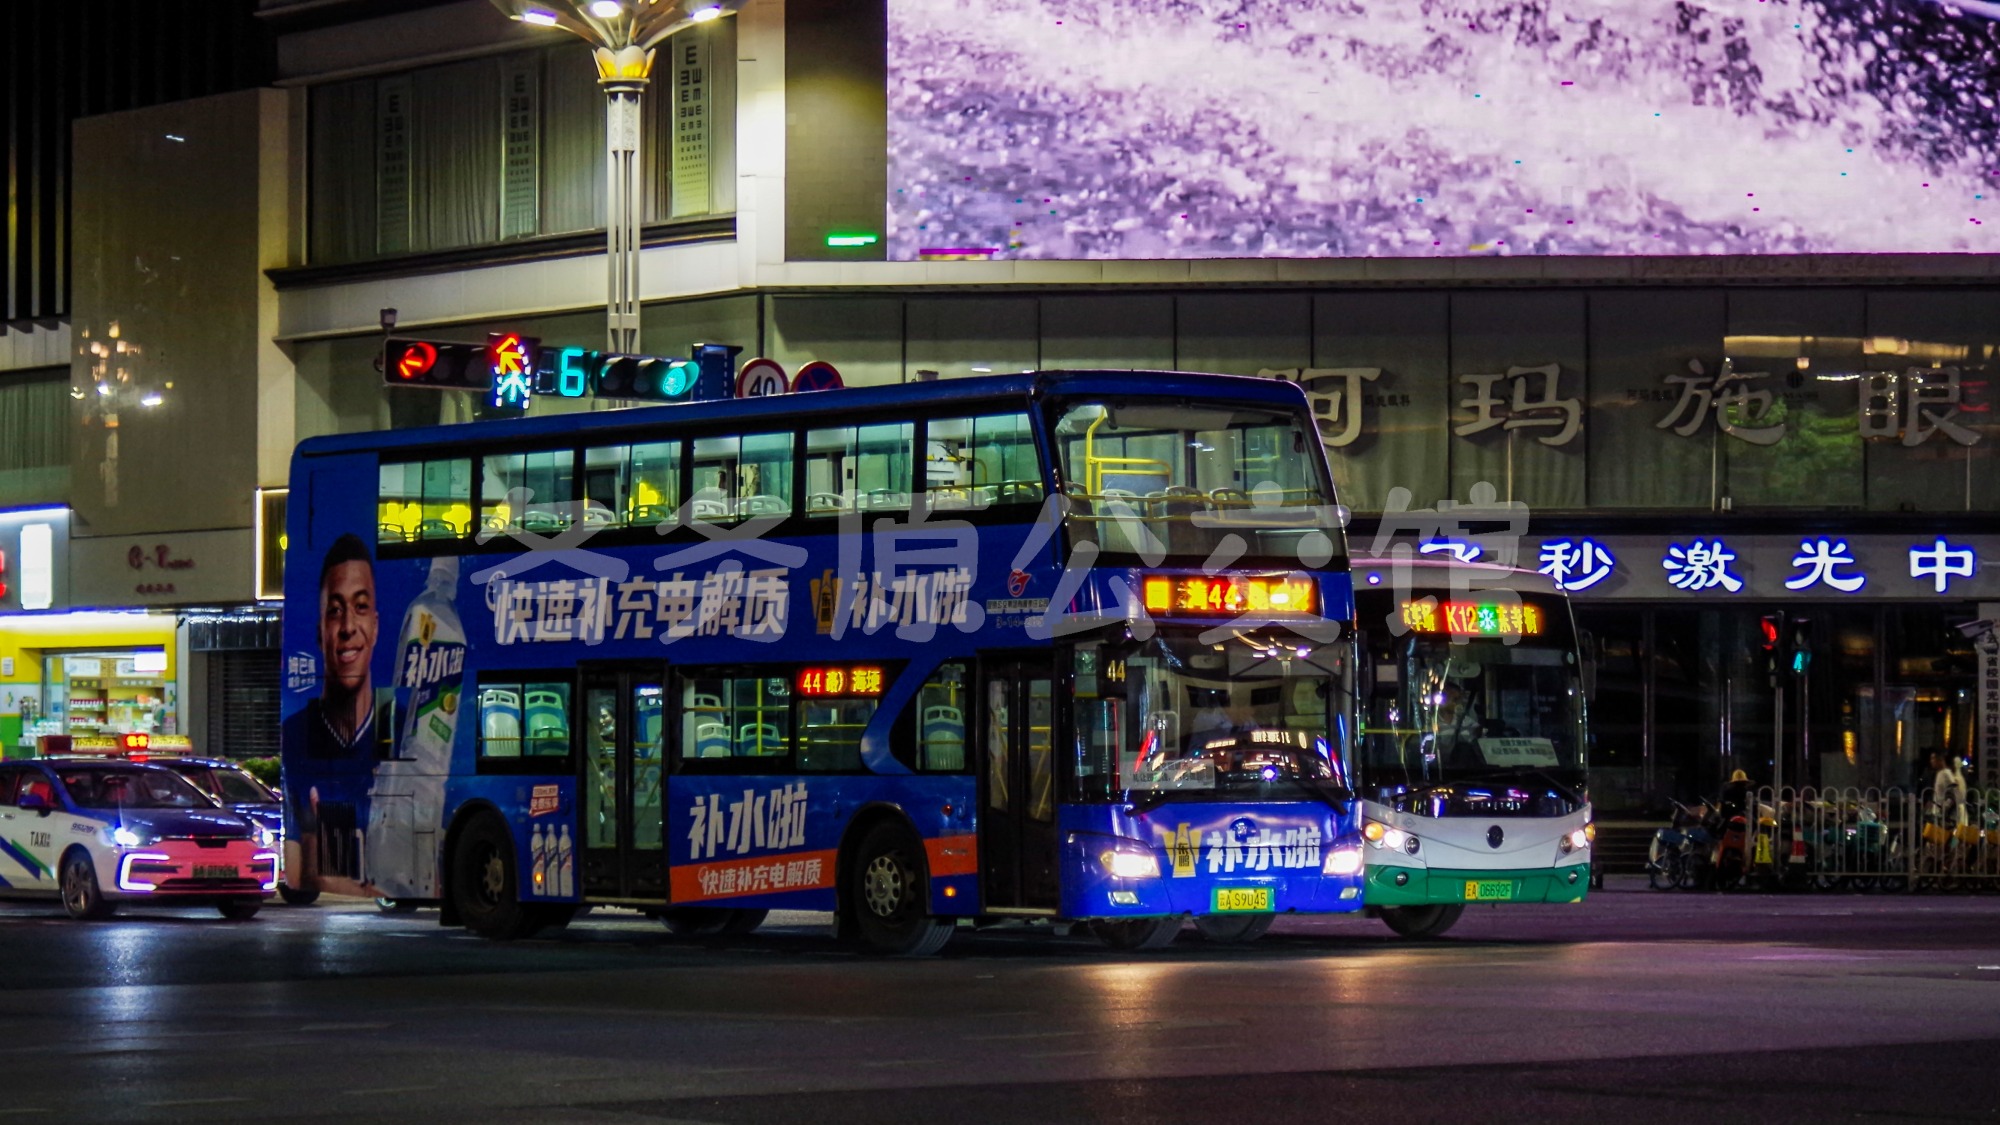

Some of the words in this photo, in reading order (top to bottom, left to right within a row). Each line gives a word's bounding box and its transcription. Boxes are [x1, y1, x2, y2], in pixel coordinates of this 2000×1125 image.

[559, 349, 584, 397] 6
[749, 375, 775, 396] 40
[495, 568, 789, 645] 快速补充电解质
[850, 567, 972, 629] 补水啦
[1446, 605, 1479, 633] K12
[405, 646, 464, 688] 补水啦
[803, 672, 821, 693] 44
[30, 831, 47, 847] TAXI
[688, 783, 808, 860] 补水啦
[1206, 826, 1322, 874] 补水啦
[701, 859, 822, 896] 快速补充电解质
